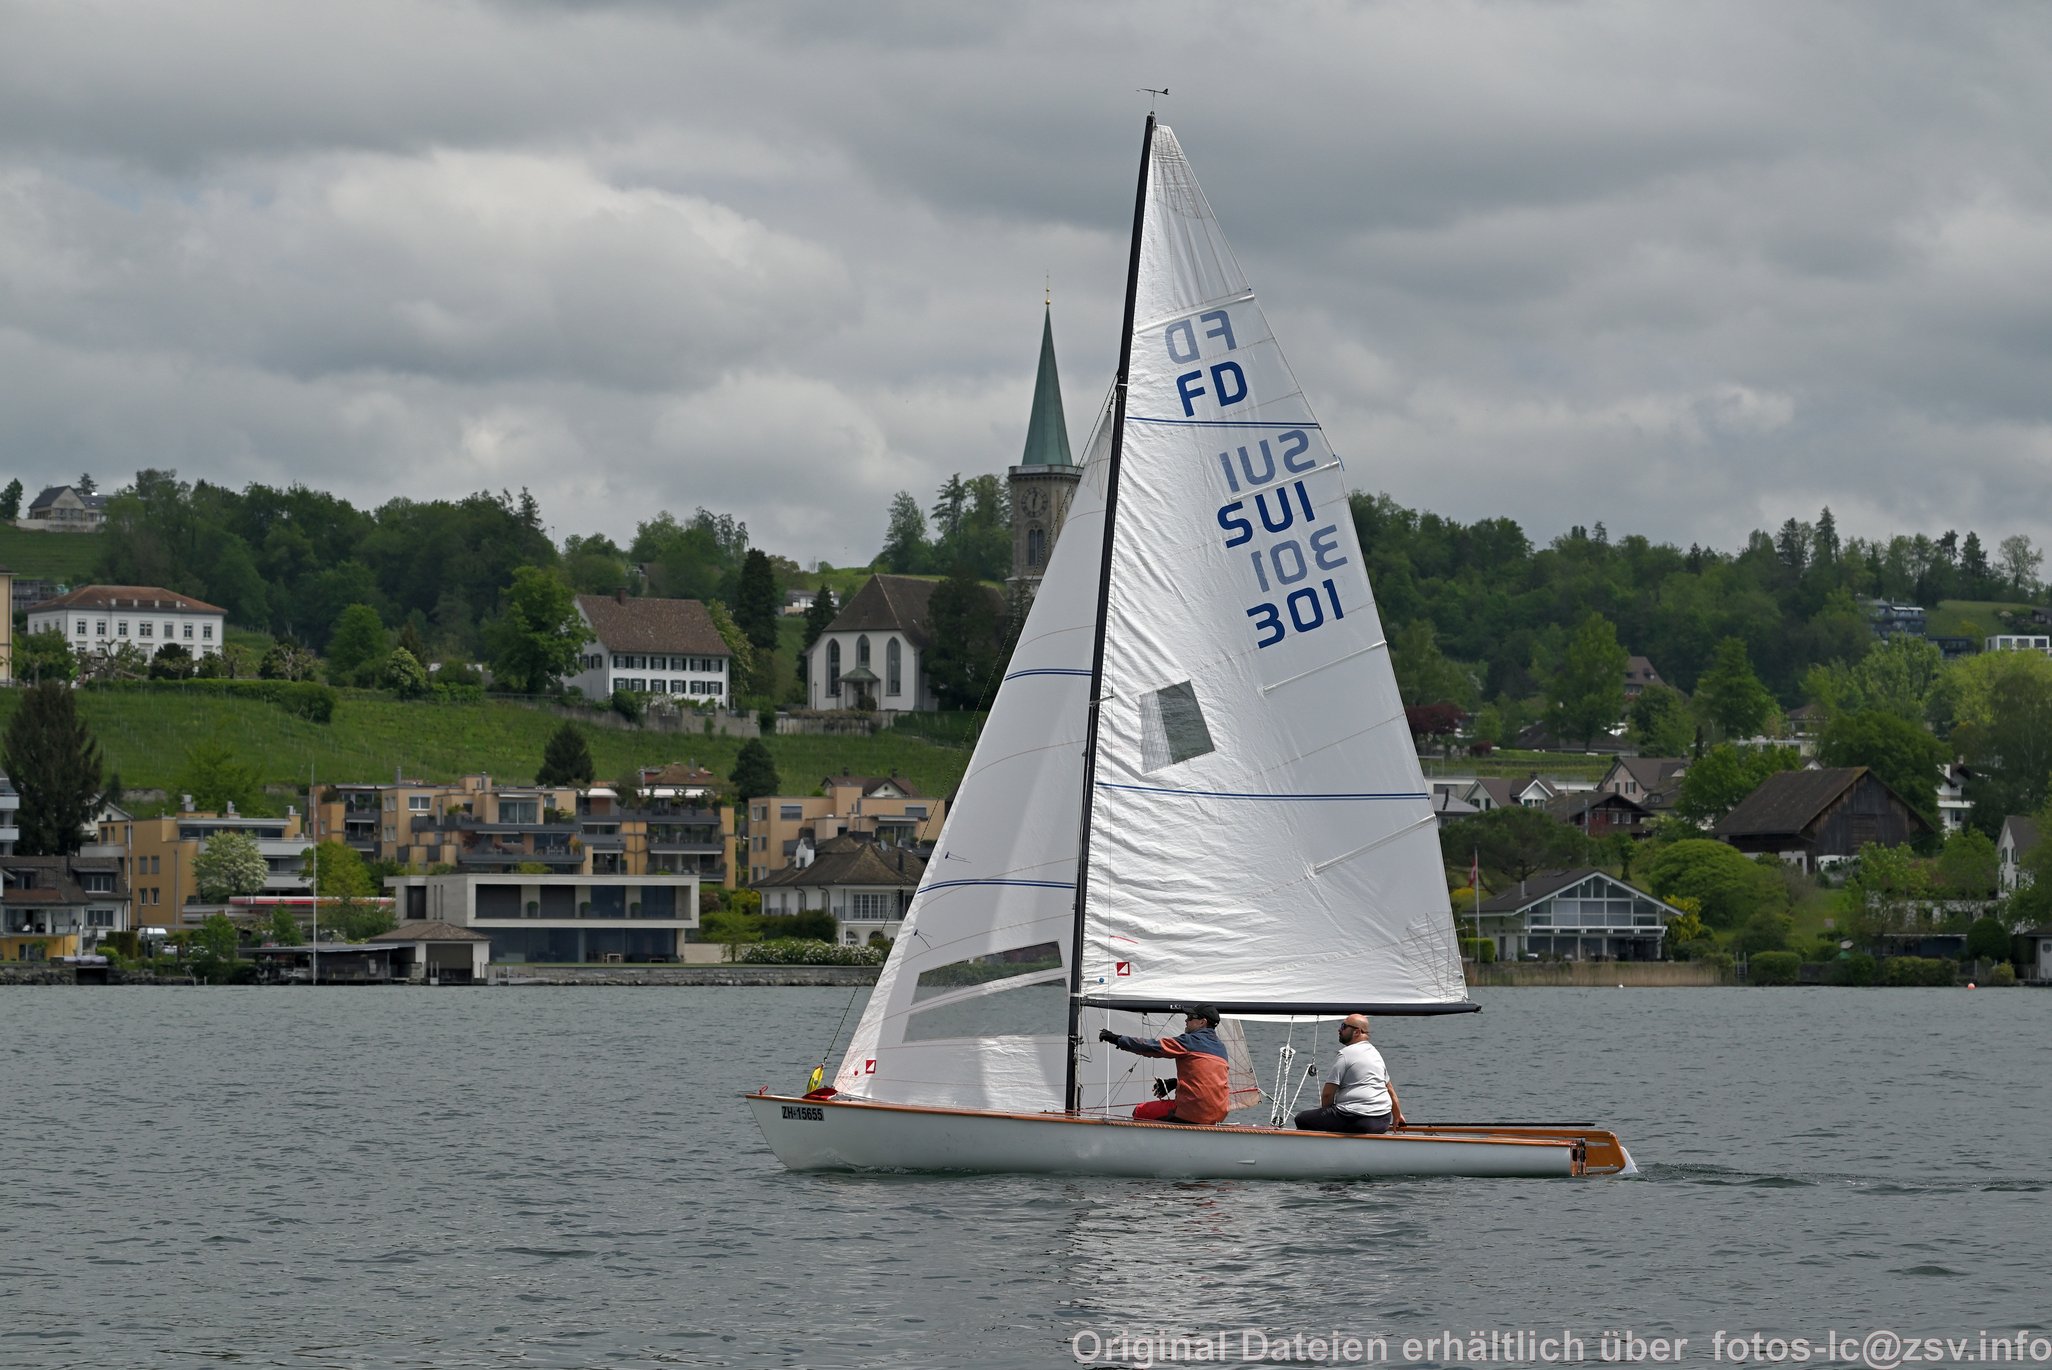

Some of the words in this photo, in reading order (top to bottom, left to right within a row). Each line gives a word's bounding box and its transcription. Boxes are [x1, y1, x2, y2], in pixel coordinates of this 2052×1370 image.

[1175, 360, 1249, 418] FD
[1216, 480, 1316, 549] SUI
[1246, 577, 1345, 650] 301
